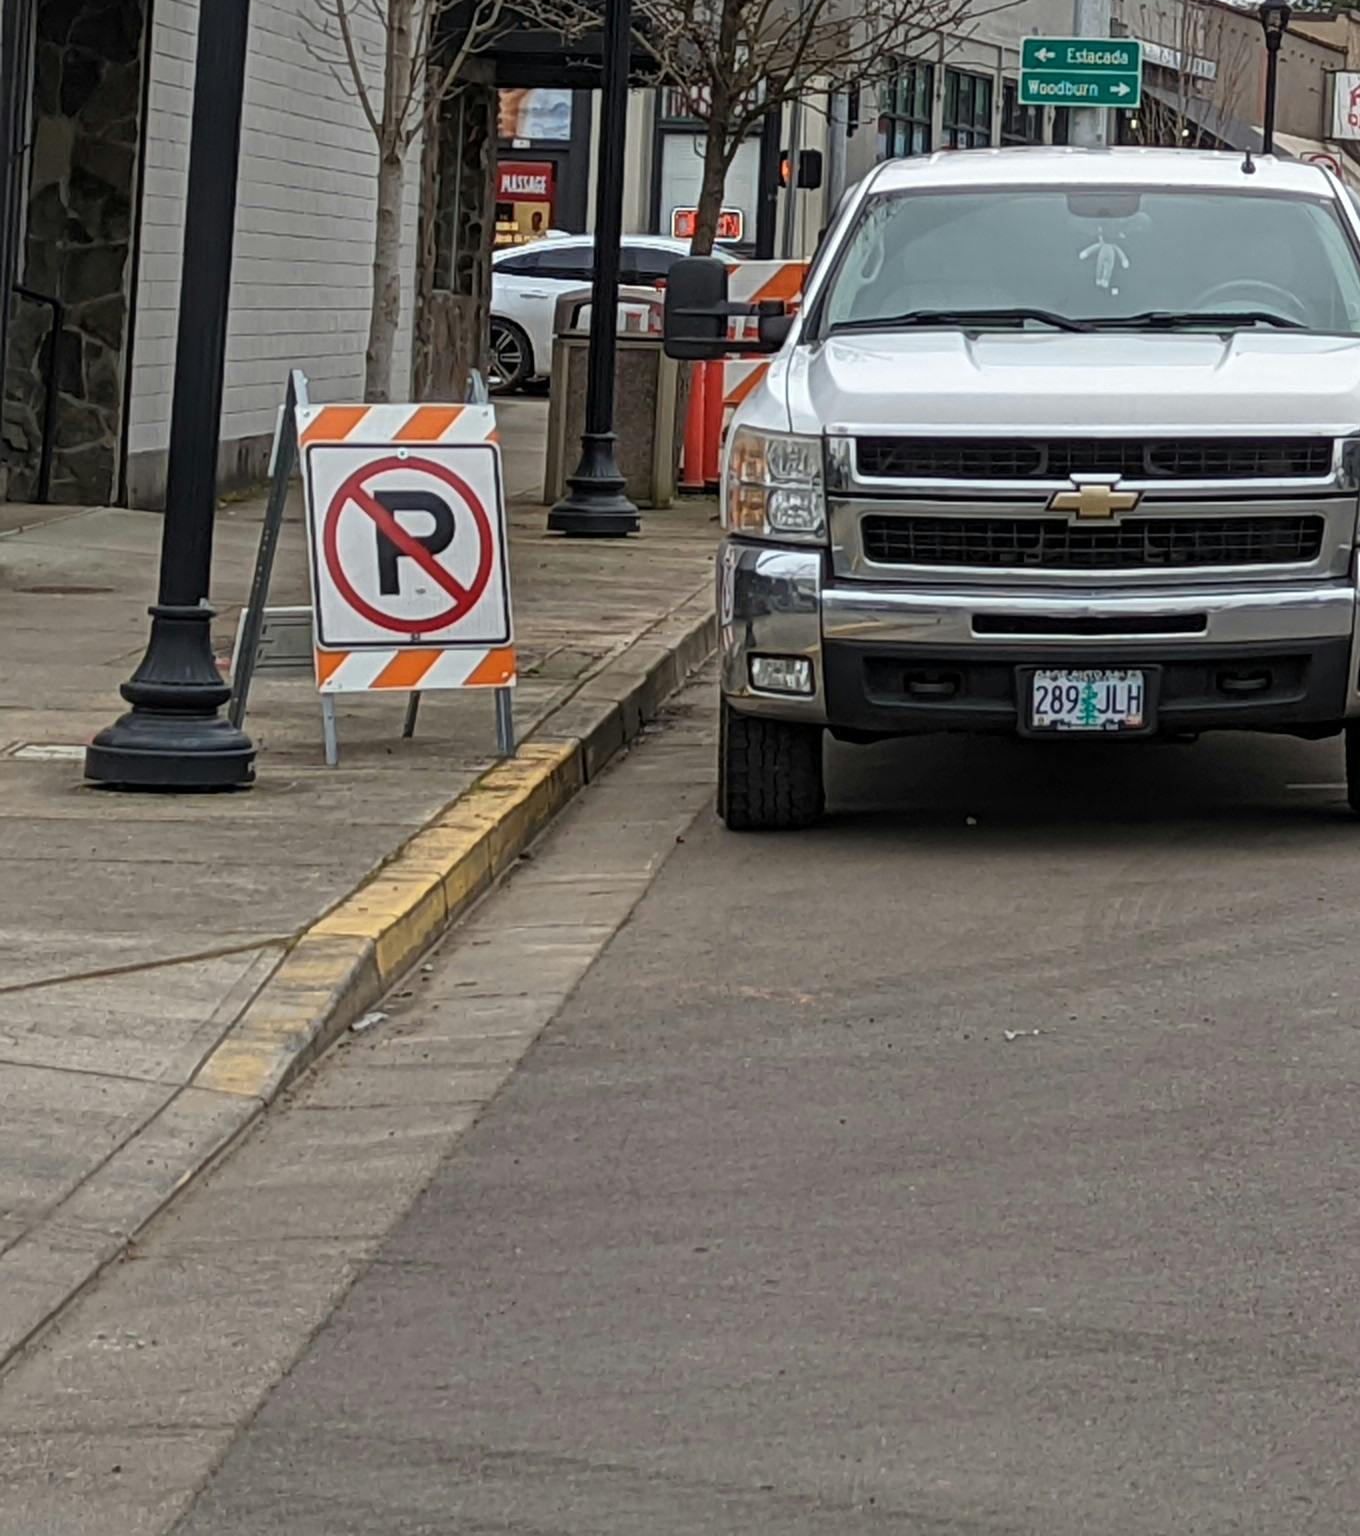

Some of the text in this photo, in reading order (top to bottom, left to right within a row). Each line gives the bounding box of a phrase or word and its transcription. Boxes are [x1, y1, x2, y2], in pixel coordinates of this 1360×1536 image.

[1066, 47, 1129, 64] Estacada
[1027, 79, 1099, 97] Woodburn
[500, 173, 547, 195] MASSAGE
[1035, 684, 1142, 715] 289 JLH
